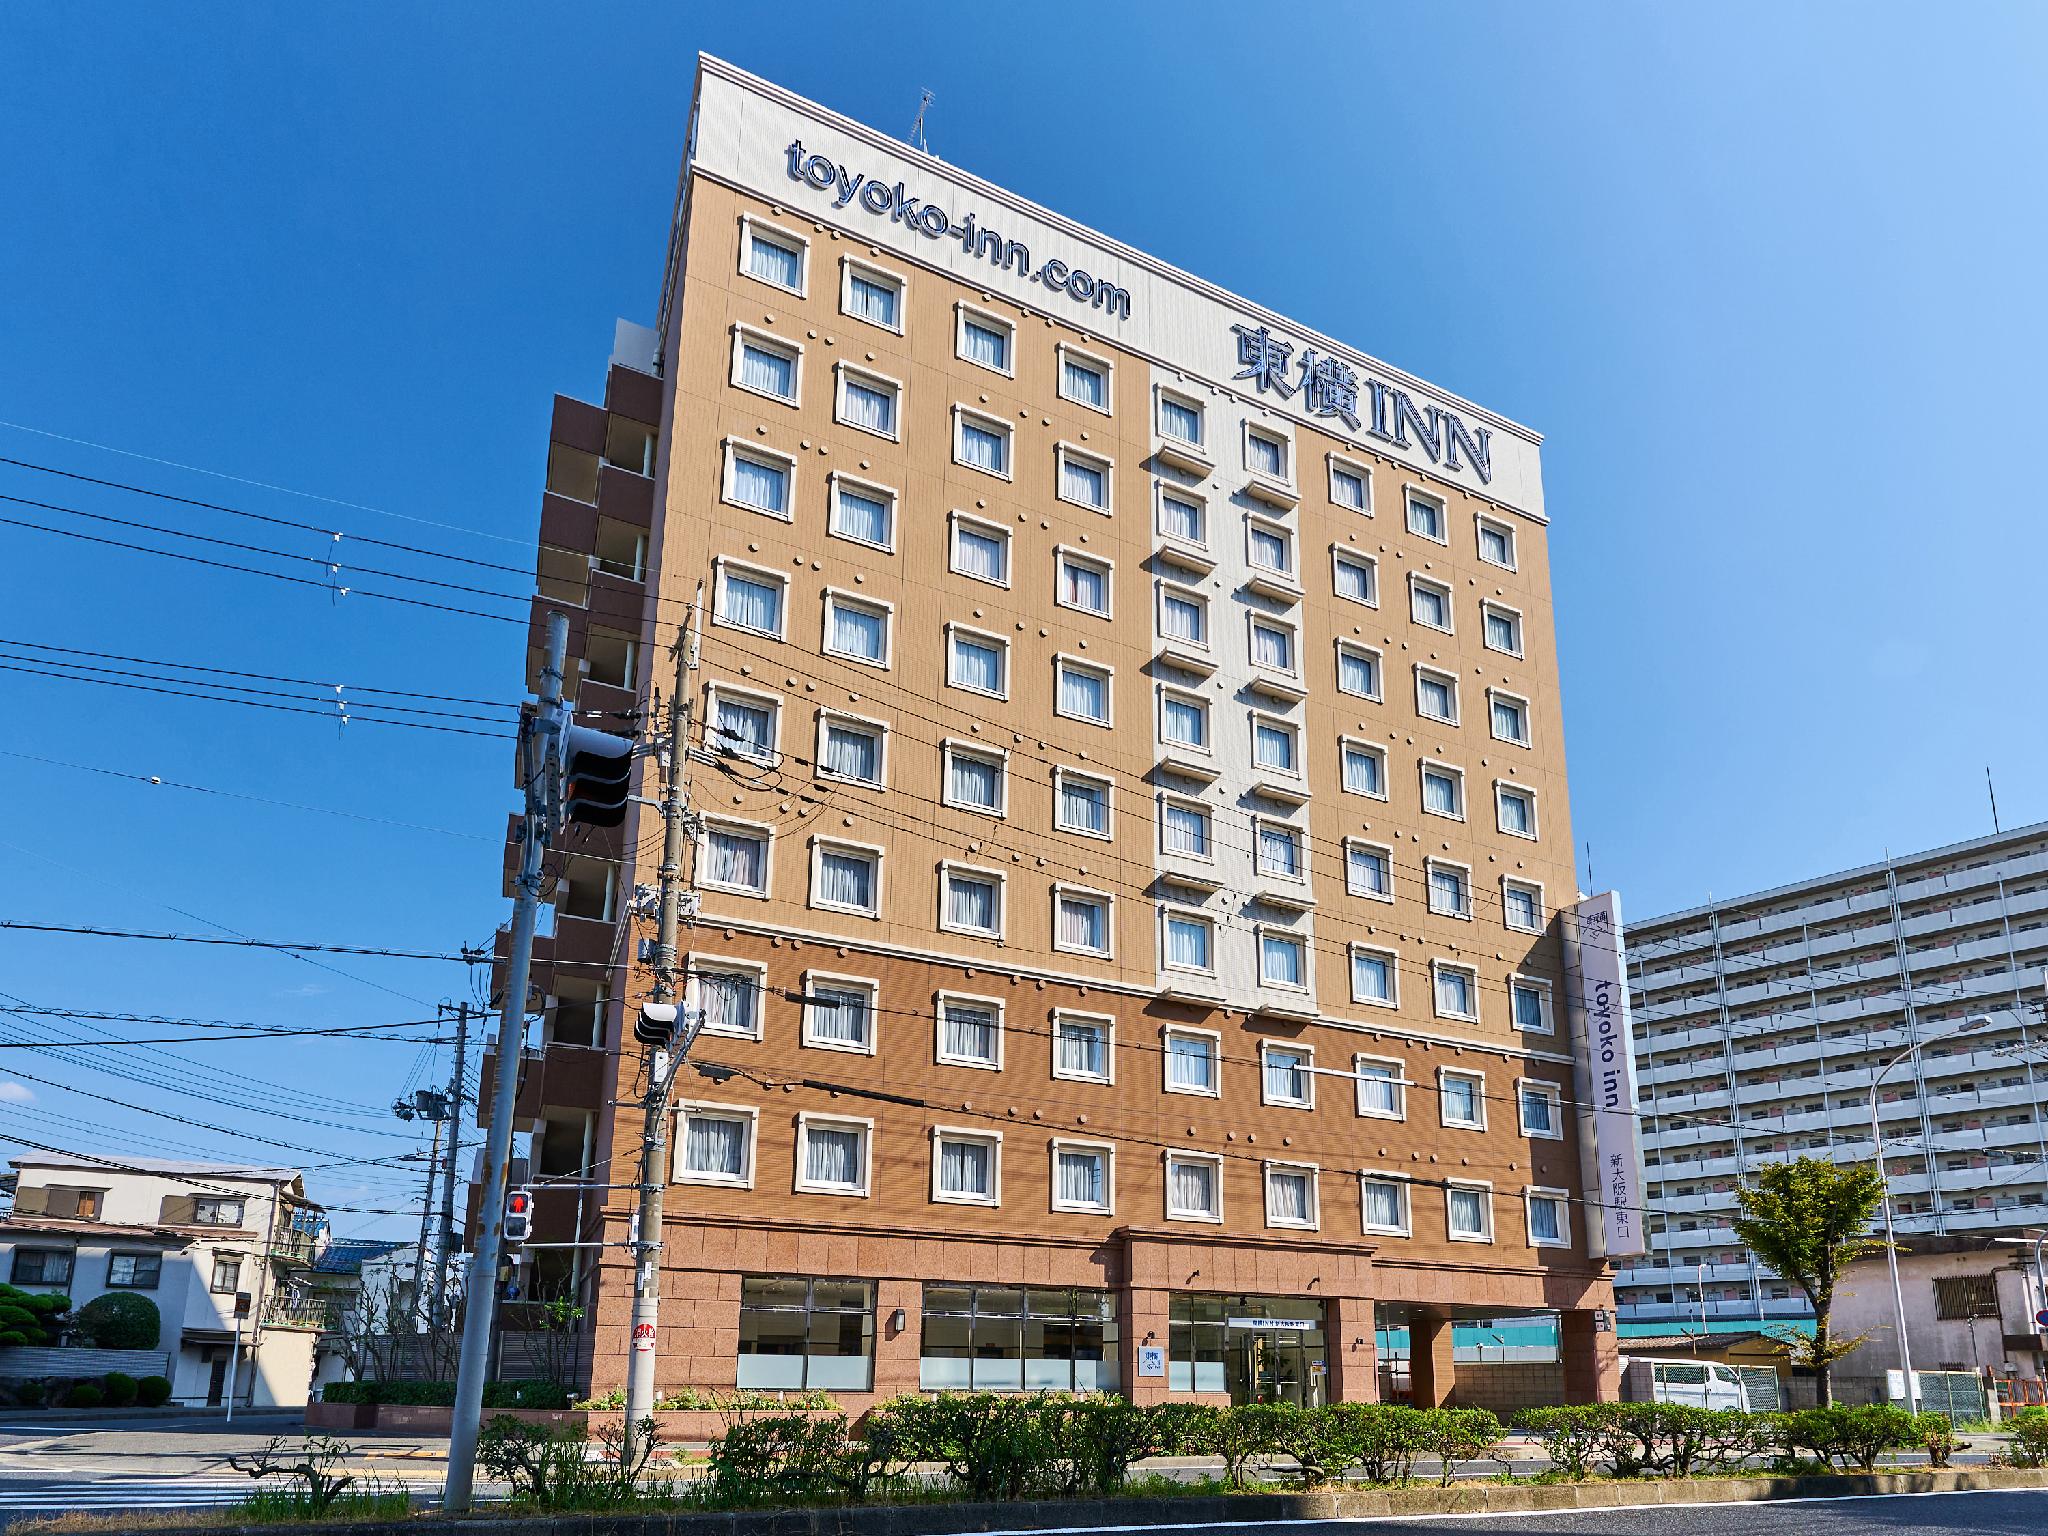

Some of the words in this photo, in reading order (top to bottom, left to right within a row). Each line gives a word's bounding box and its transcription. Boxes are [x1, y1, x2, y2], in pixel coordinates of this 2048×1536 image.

[784, 139, 1131, 320] toyoko-inn.com
[1594, 980, 1618, 1063] toyoko
[1603, 1069, 1620, 1107] inn
[1610, 1153, 1630, 1238] 新大阪駅東口
